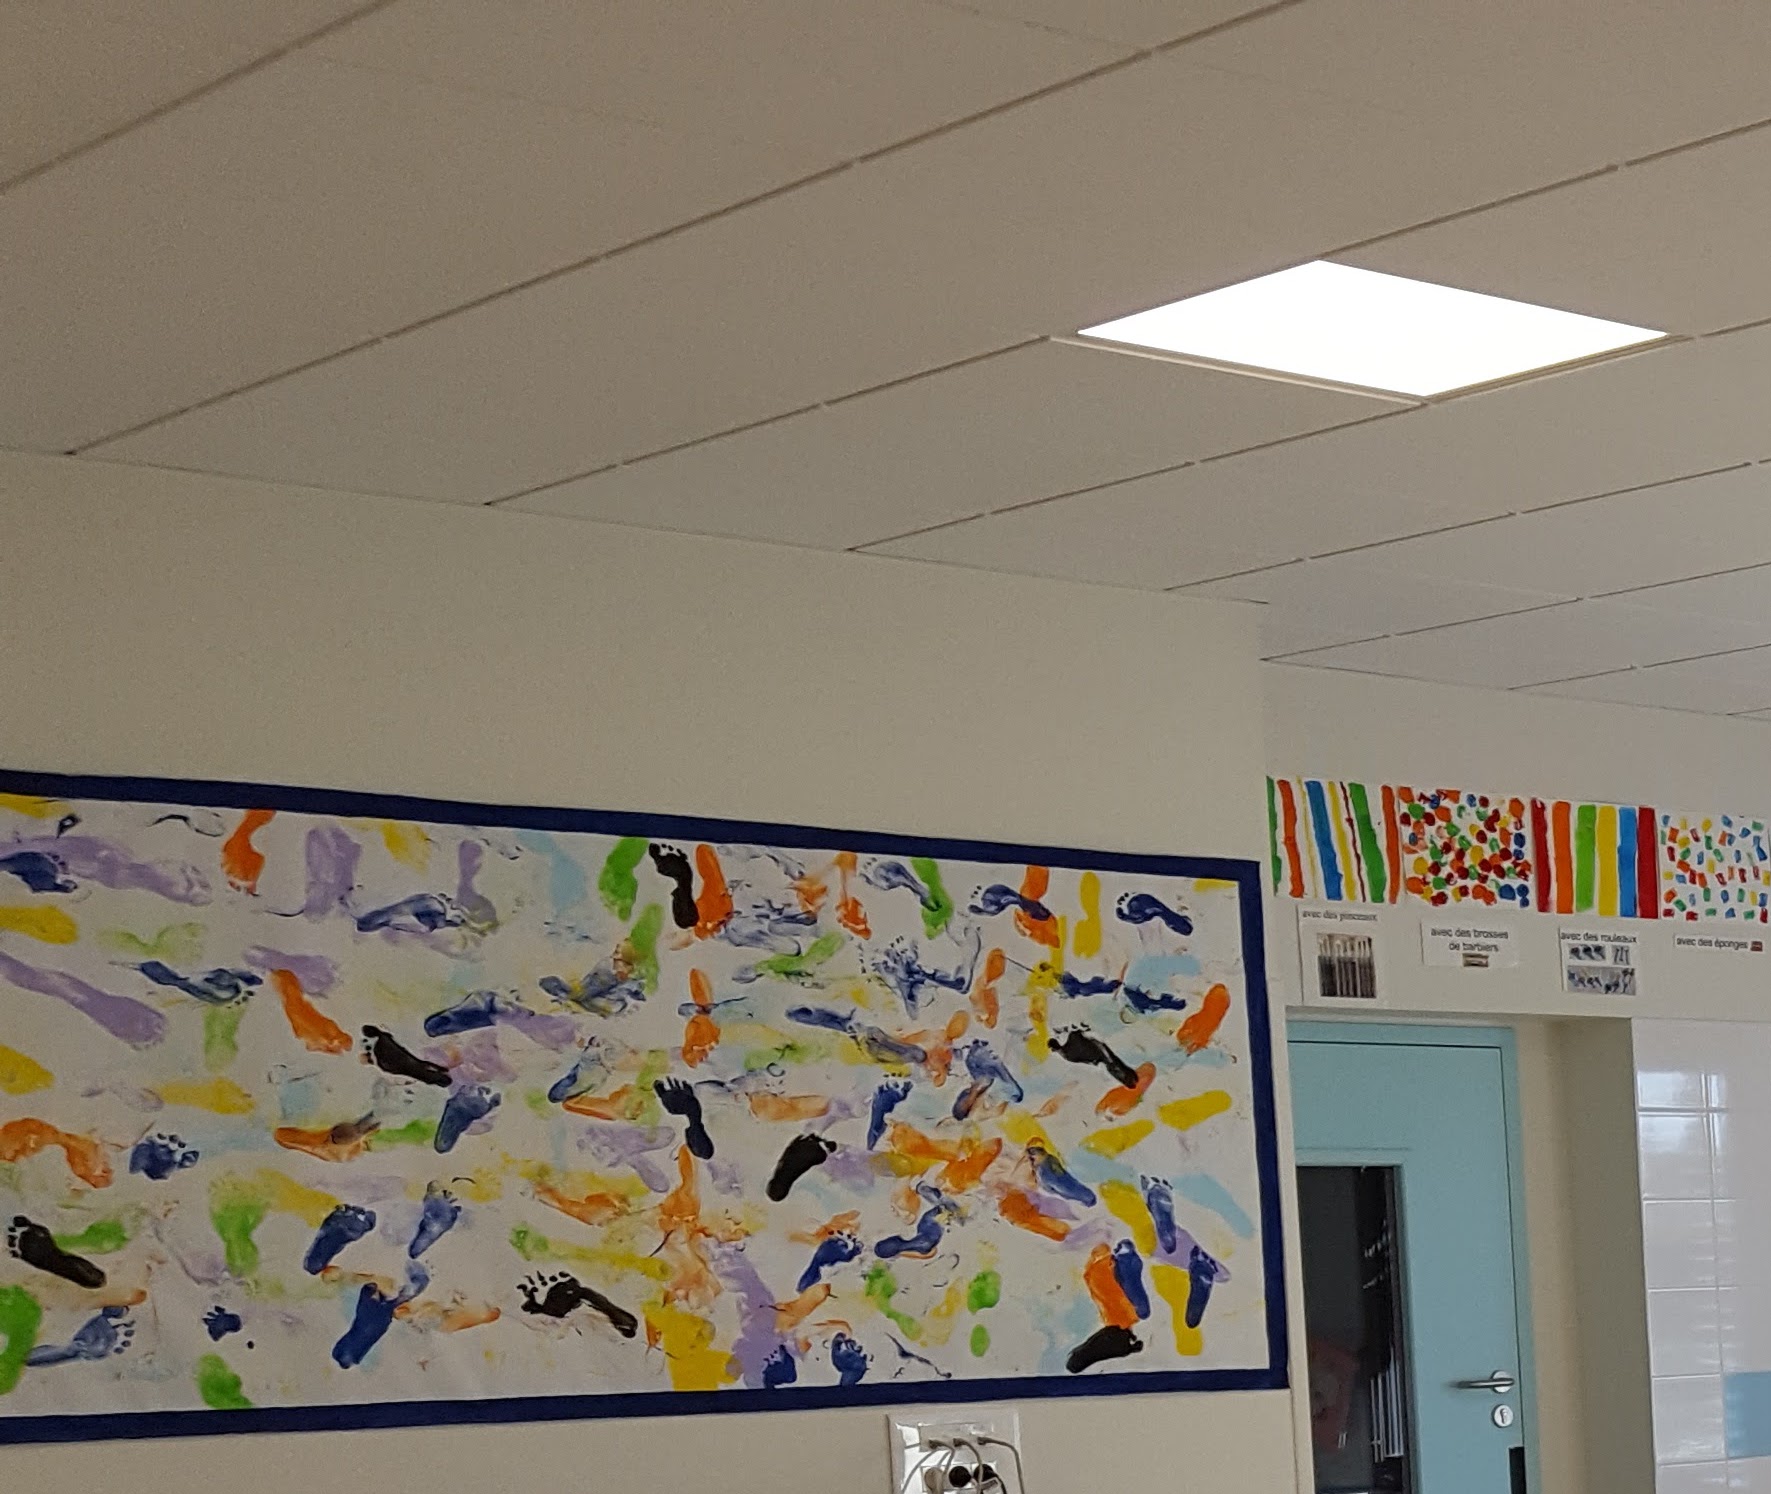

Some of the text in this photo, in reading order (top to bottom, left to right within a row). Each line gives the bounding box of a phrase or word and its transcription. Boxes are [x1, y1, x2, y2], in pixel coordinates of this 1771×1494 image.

[1430, 927, 1453, 938] avec
[1455, 927, 1471, 938] des
[1560, 931, 1581, 942] avec
[1583, 931, 1598, 942] des
[1676, 937, 1749, 950] avec des éponges
